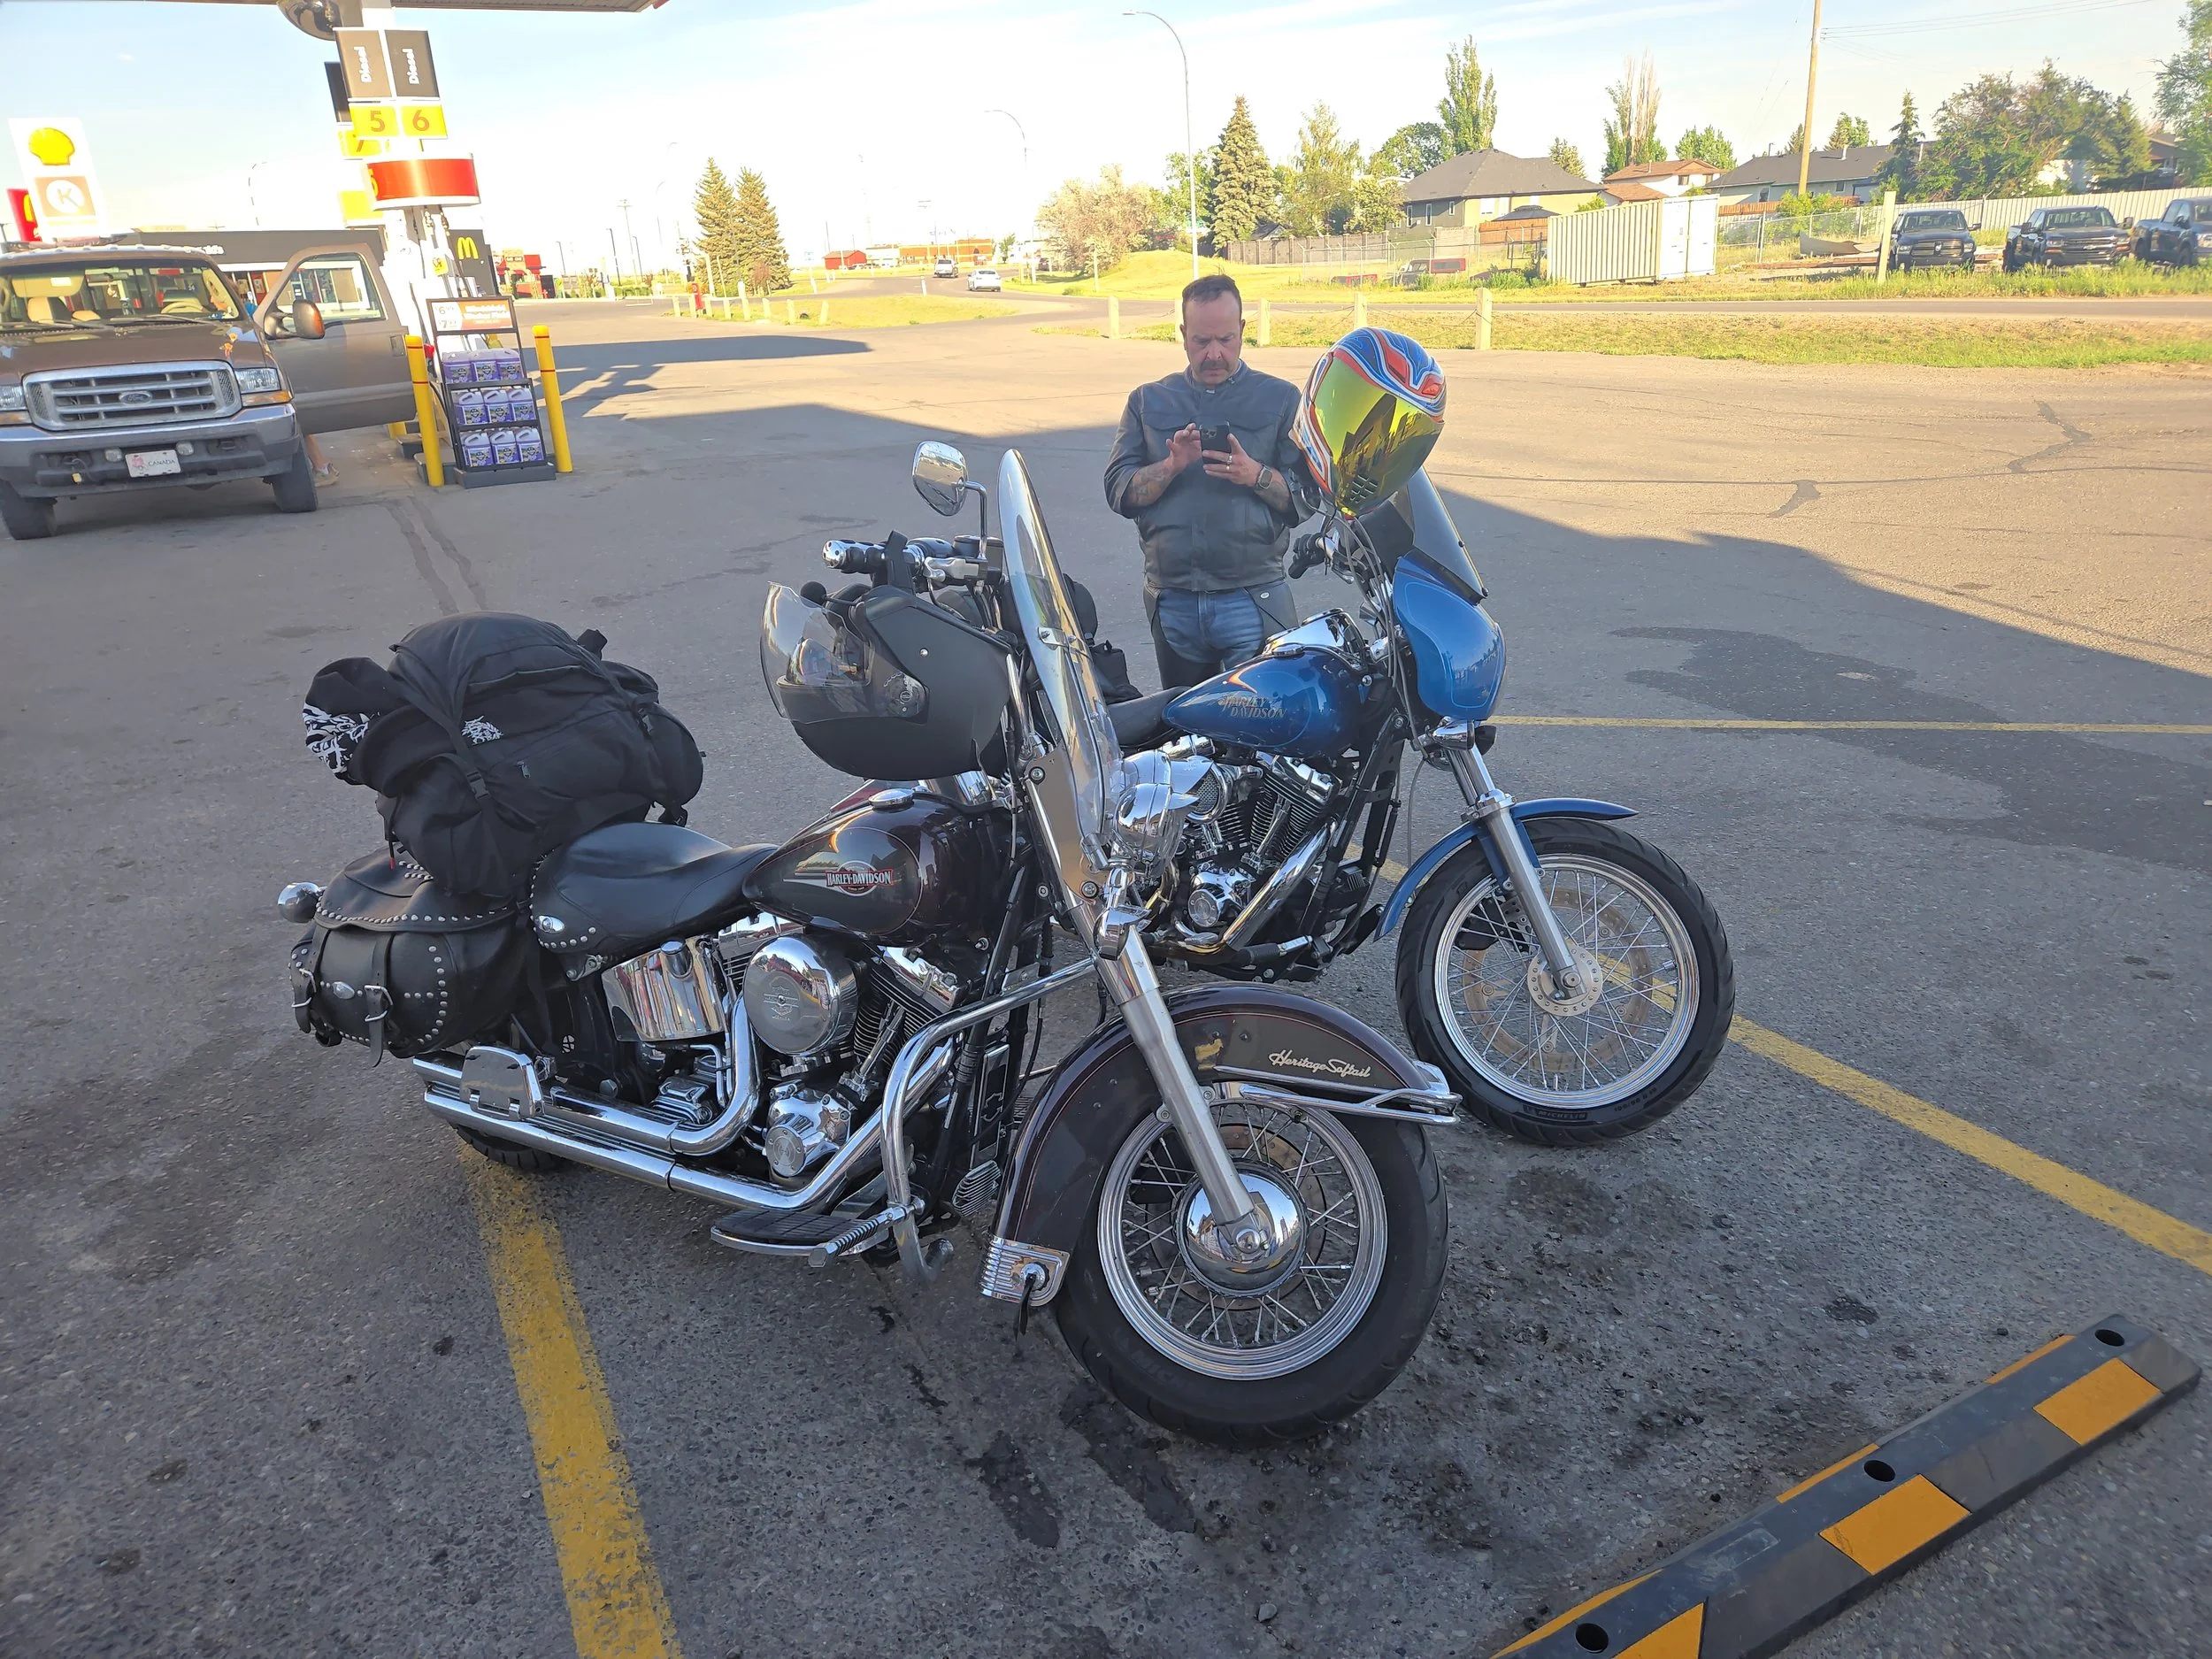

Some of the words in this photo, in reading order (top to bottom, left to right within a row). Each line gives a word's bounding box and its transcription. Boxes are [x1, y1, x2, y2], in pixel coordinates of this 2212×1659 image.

[354, 46, 373, 83] Diesel
[402, 48, 419, 84] Diesel
[370, 111, 386, 132] 5
[412, 110, 430, 132] 6
[1217, 695, 1267, 712] HARLEY
[1230, 707, 1287, 718] DAVIDSON
[1269, 1049, 1327, 1073] Heritage
[1328, 1058, 1371, 1078] Softail
[1538, 1110, 1586, 1120] MICHELIN
